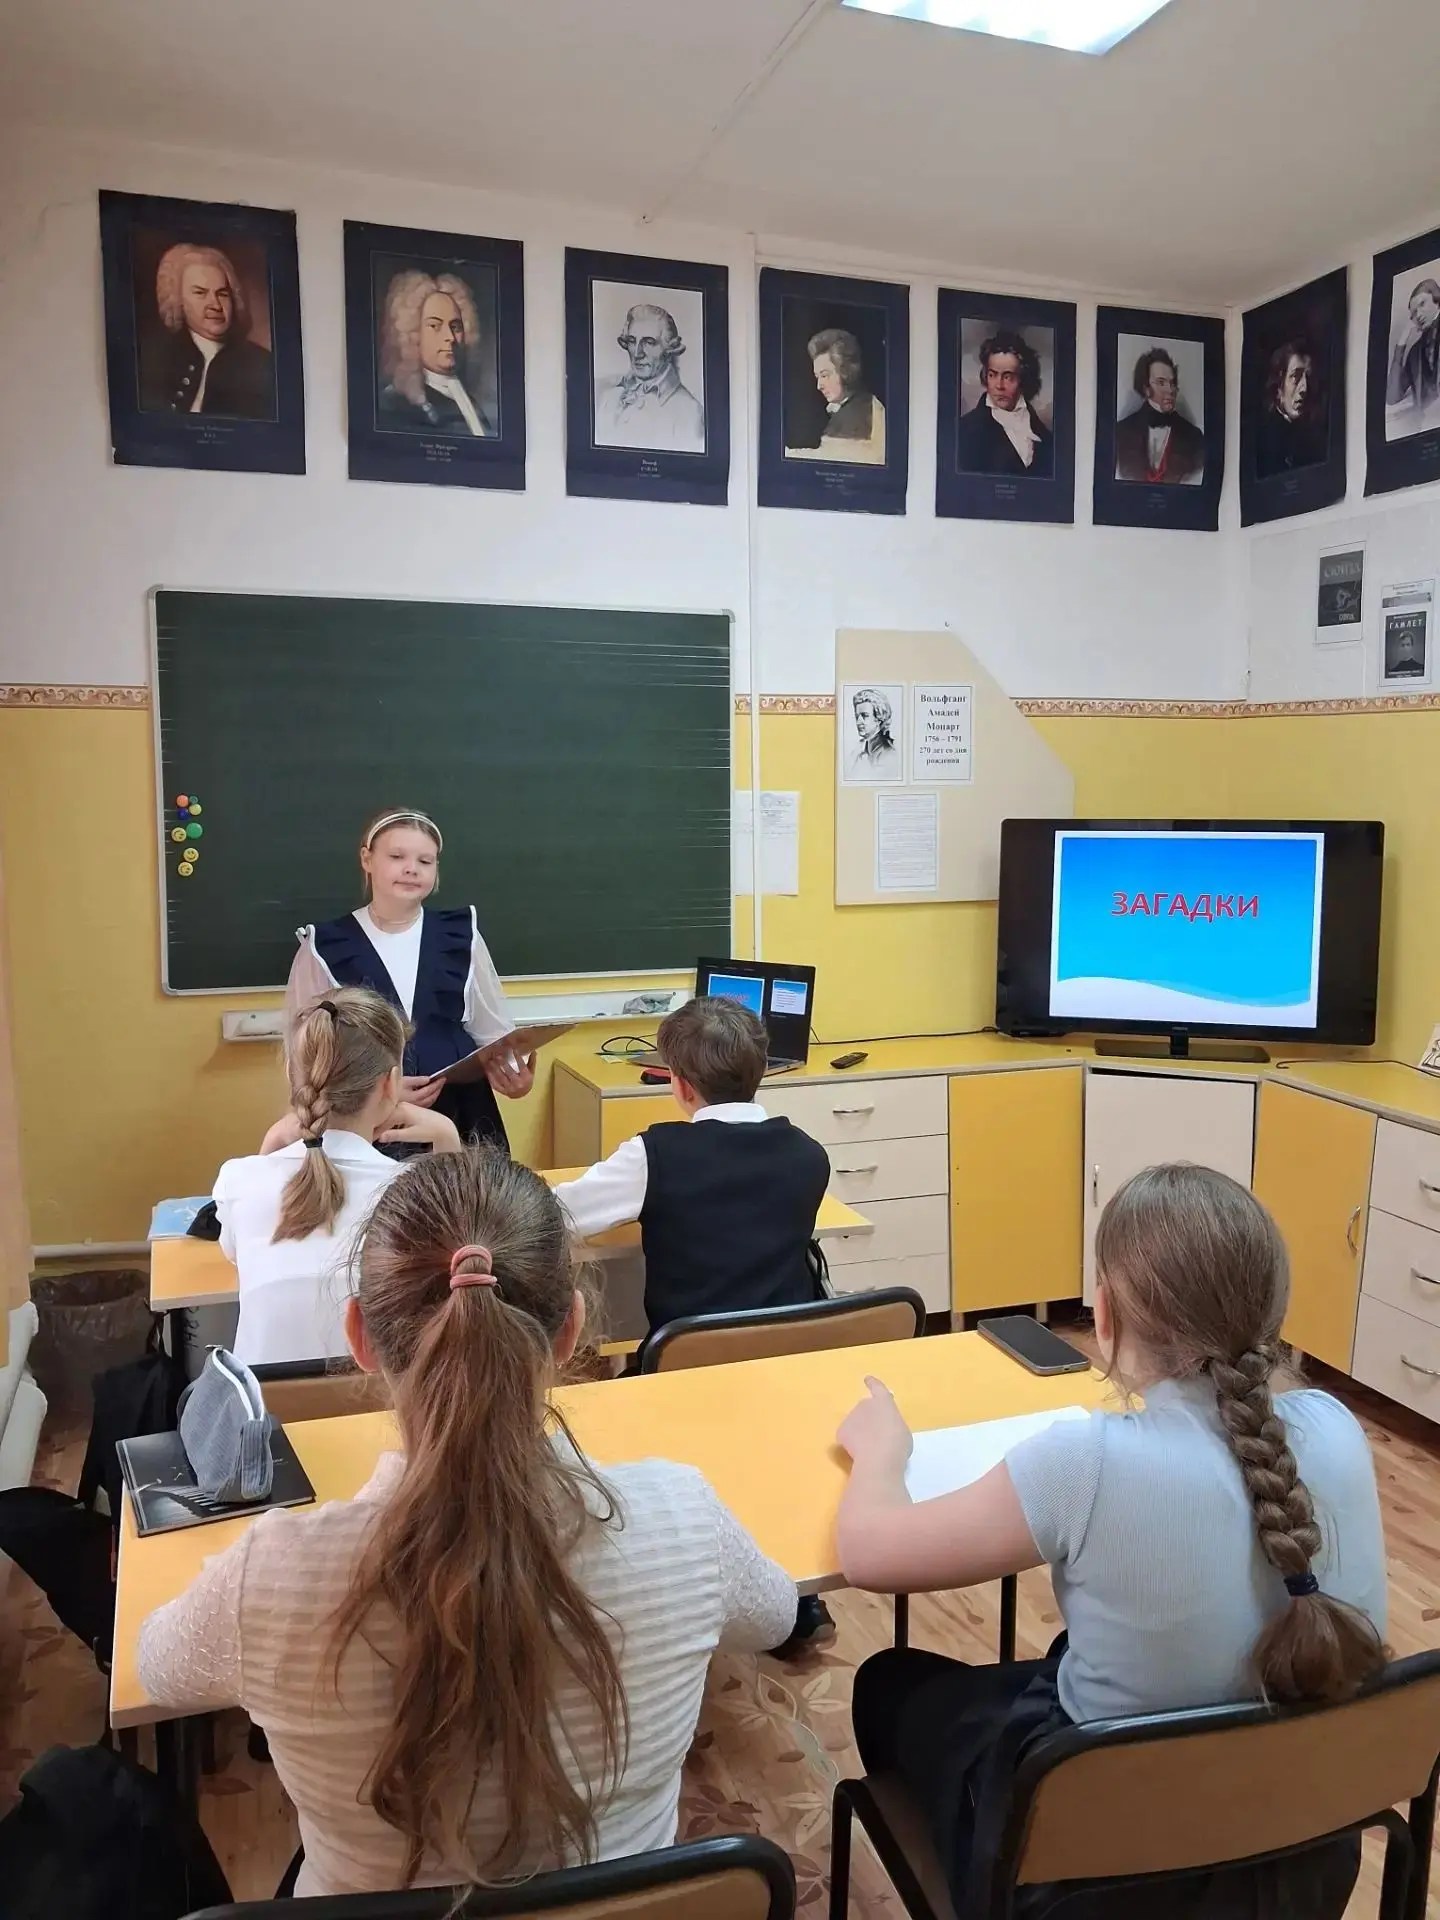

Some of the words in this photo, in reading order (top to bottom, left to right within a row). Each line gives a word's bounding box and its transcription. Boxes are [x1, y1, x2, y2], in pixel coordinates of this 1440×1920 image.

[920, 694, 967, 704] Вольфганг
[928, 708, 960, 717] Амадей
[927, 722, 960, 732] Моцарт
[1111, 891, 1260, 923] ЗАГАДКИ
